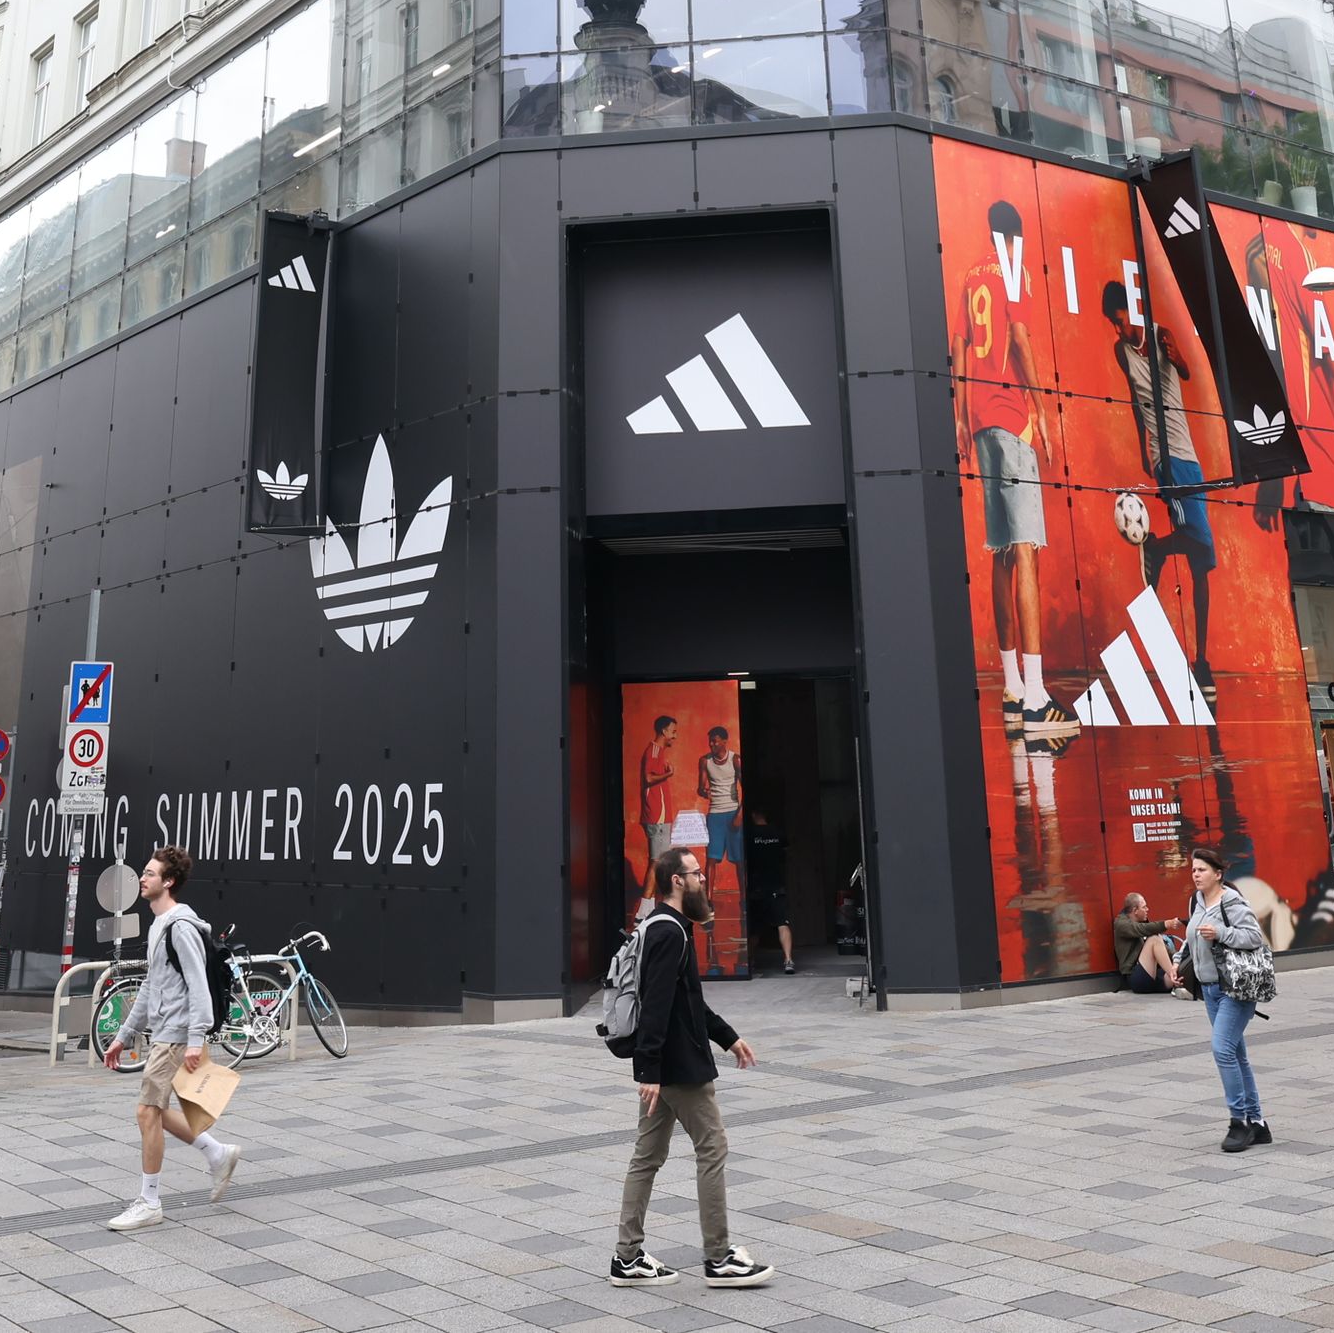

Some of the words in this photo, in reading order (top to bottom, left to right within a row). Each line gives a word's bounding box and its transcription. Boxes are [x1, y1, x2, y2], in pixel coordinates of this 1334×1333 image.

[78, 739, 95, 757] 30
[1129, 788, 1152, 800] KOMM
[1154, 788, 1163, 799] IN
[1130, 804, 1155, 816] UNSER
[1157, 803, 1181, 815] TEAM!
[153, 786, 303, 861] SUMMER
[332, 782, 445, 866] 2025
[251, 992, 281, 1000] comix
